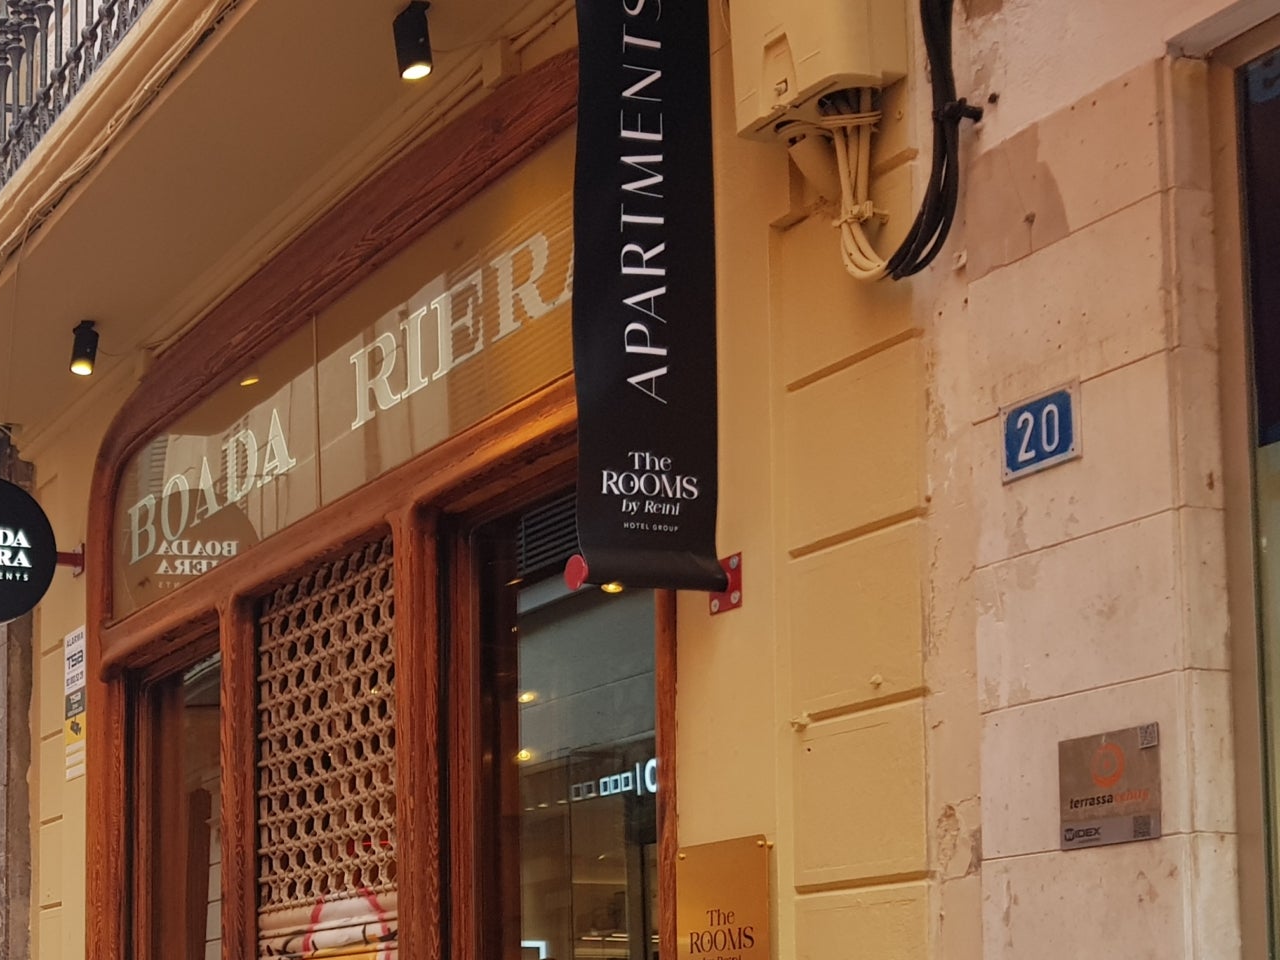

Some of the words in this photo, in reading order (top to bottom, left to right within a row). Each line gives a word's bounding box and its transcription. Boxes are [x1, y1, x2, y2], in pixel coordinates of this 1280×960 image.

[128, 408, 297, 566] BOADA
[349, 231, 574, 431] RIER
[1016, 403, 1060, 462] 20
[628, 451, 672, 471] The
[601, 470, 699, 500] ROOMS
[622, 499, 640, 515] by
[623, 522, 650, 531] HOTEL
[652, 524, 679, 532] GROUP
[706, 909, 735, 927] The
[689, 926, 755, 955] ROOMS
